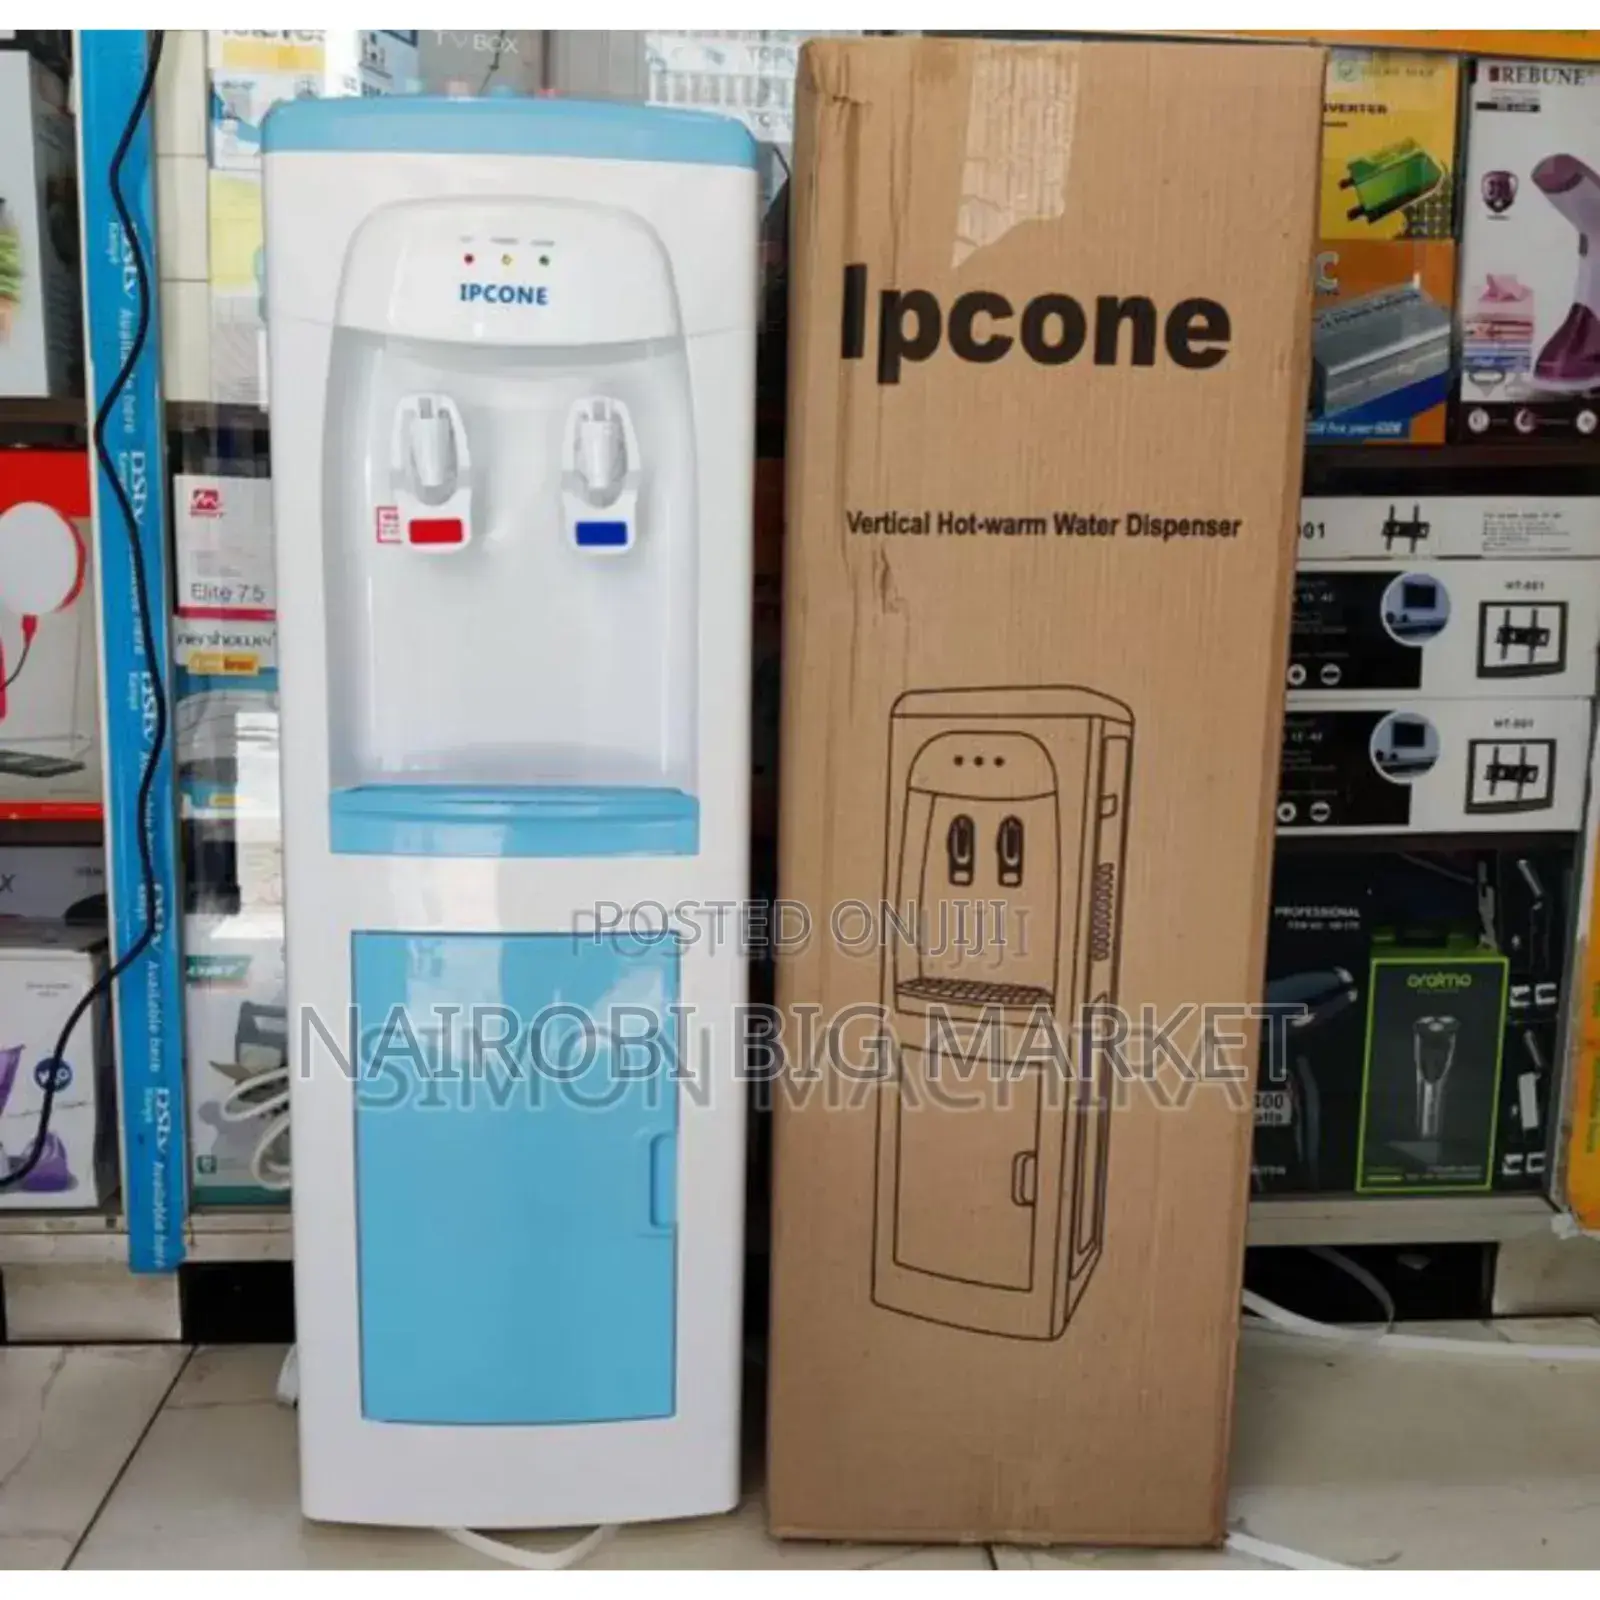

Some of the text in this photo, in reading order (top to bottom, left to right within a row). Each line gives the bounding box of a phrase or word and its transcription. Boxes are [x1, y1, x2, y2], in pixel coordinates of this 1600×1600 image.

[473, 33, 519, 54] BOX
[1501, 65, 1589, 86] REBUNE
[459, 283, 549, 305] IPCONE
[841, 262, 1232, 385] Ipcone
[845, 510, 1242, 543] Vertical Hot-warm Water Dispenser
[191, 584, 232, 602] Elite
